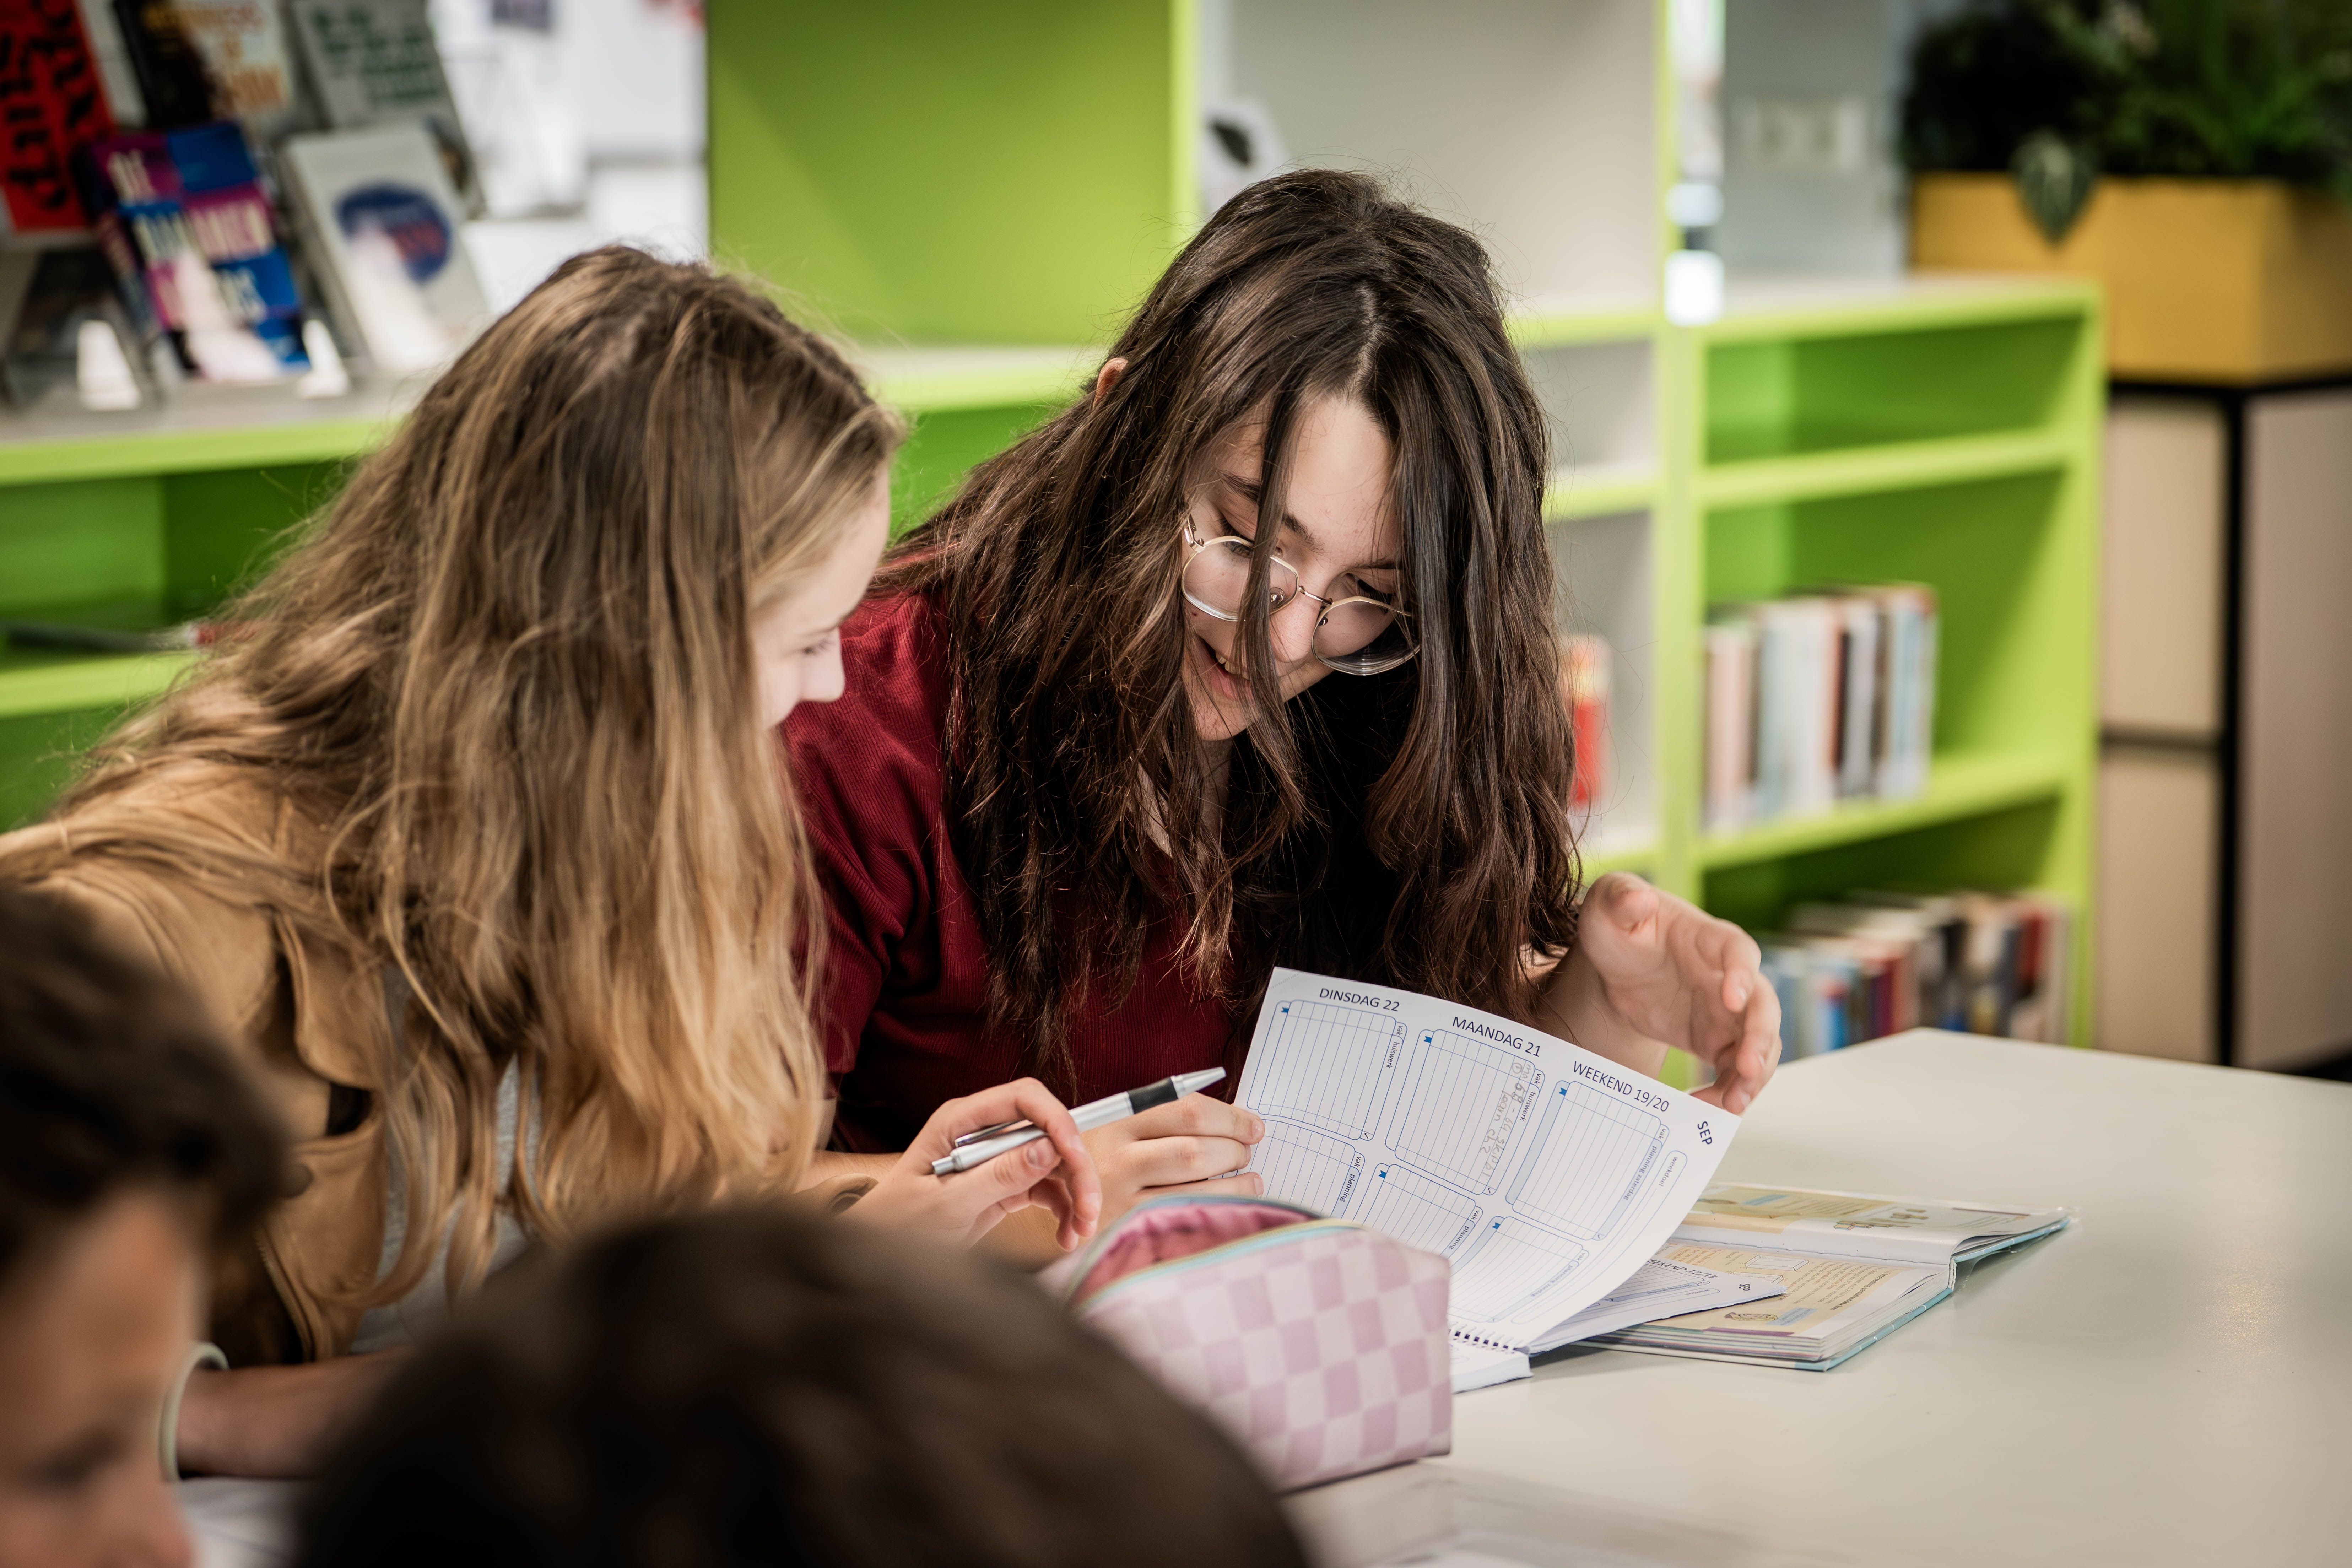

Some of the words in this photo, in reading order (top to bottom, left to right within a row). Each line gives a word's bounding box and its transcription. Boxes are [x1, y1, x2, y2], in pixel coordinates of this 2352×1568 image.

[1319, 988, 1380, 1007] DINSDAG
[1383, 1000, 1400, 1011] 22
[1452, 1017, 1523, 1049] MAANDAG
[1525, 1042, 1540, 1057] 21
[1386, 1042, 1400, 1068] huiswerk
[1573, 1061, 1632, 1095] WEEKEND
[1634, 1089, 1669, 1112] 19/20
[1520, 1091, 1536, 1121] huiswerk
[1658, 1129, 1666, 1140] vak
[1697, 1121, 1713, 1145] SEP
[1639, 1146, 1657, 1173] planning
[1659, 1157, 1678, 1186] weekdoel
[1340, 1173, 1355, 1202] planning
[1623, 1174, 1642, 1200] zaterdag
[1471, 1210, 1480, 1220] vak
[1449, 1226, 1469, 1250] planning
[1647, 1259, 1687, 1271] EEKEND
[1686, 1270, 1718, 1278] 12/13
